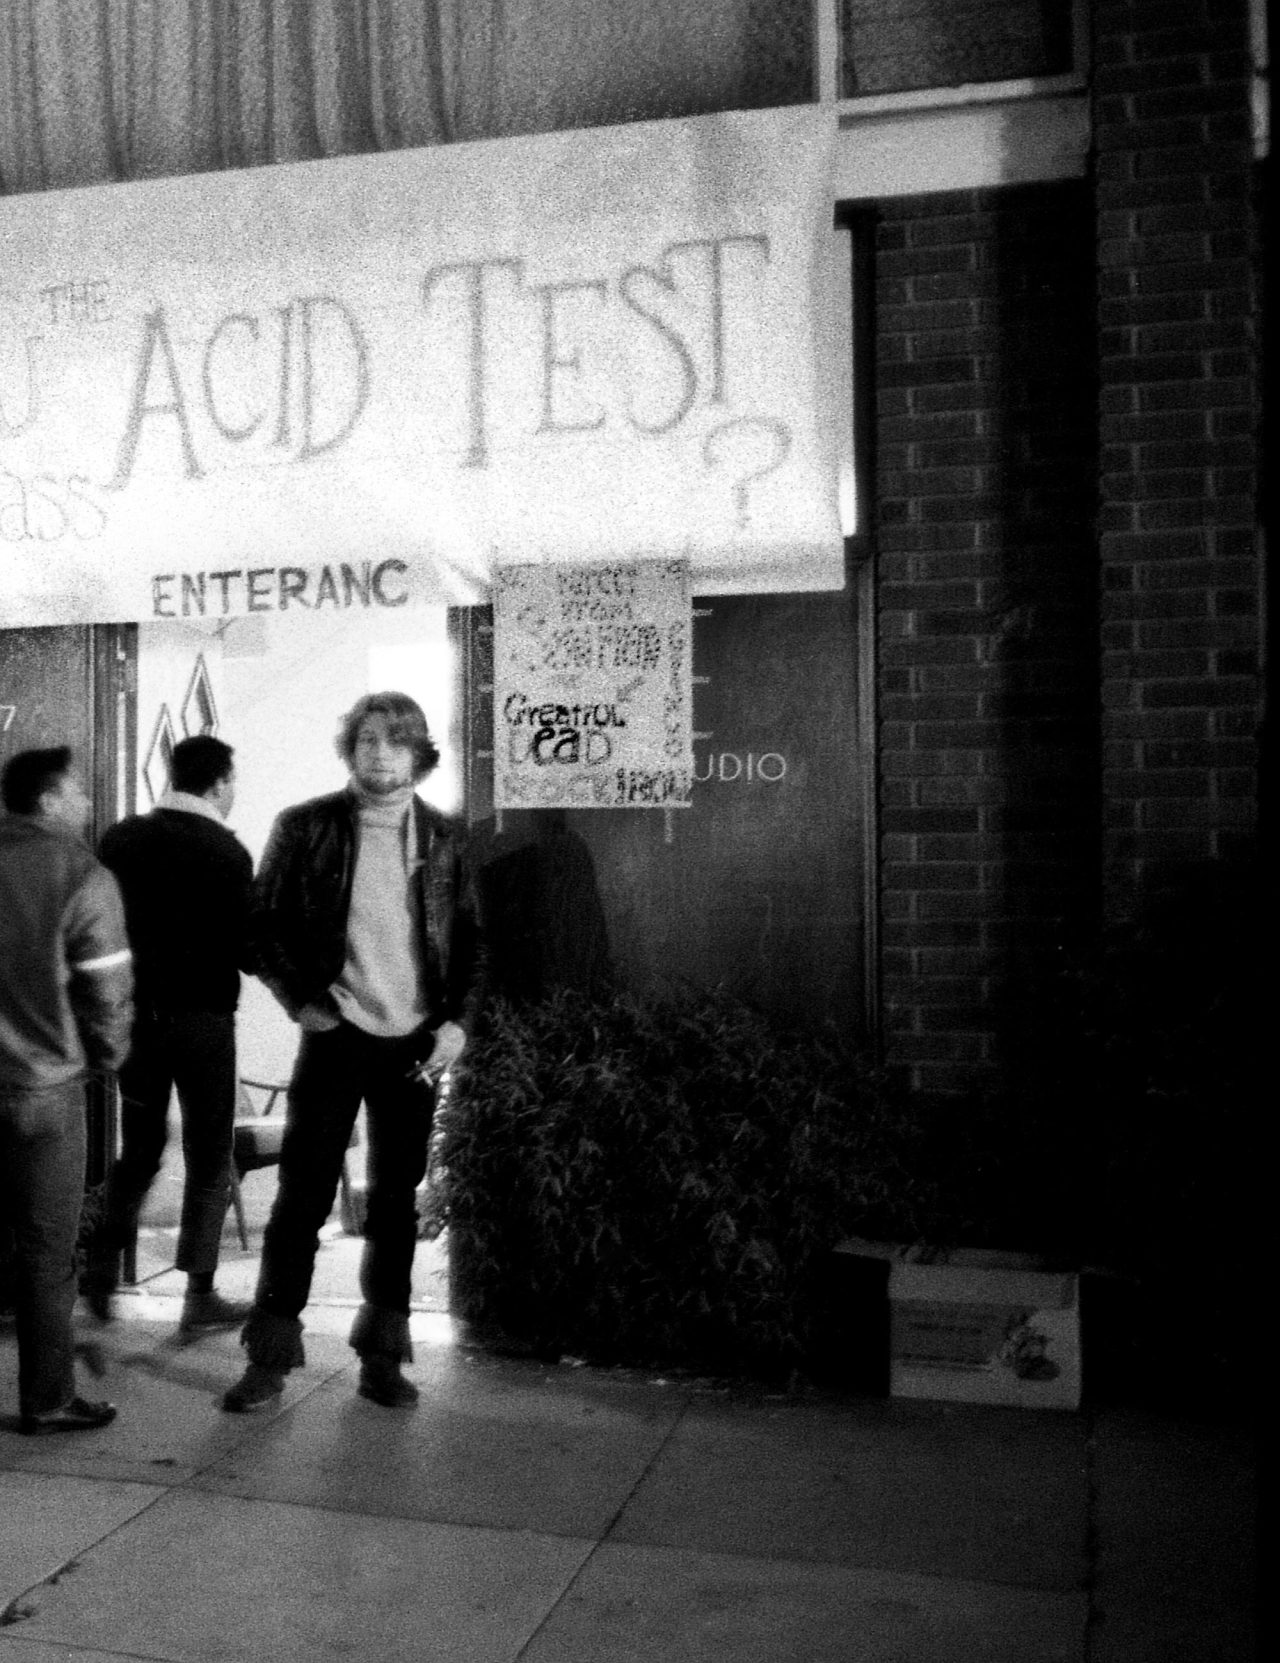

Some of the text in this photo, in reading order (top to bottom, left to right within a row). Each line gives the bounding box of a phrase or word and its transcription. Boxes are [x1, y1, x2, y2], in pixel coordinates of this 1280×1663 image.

[39, 278, 114, 325] THE
[99, 233, 771, 491] ACID TEST
[151, 557, 410, 617] ENTERANC
[694, 752, 787, 783] UDIO
